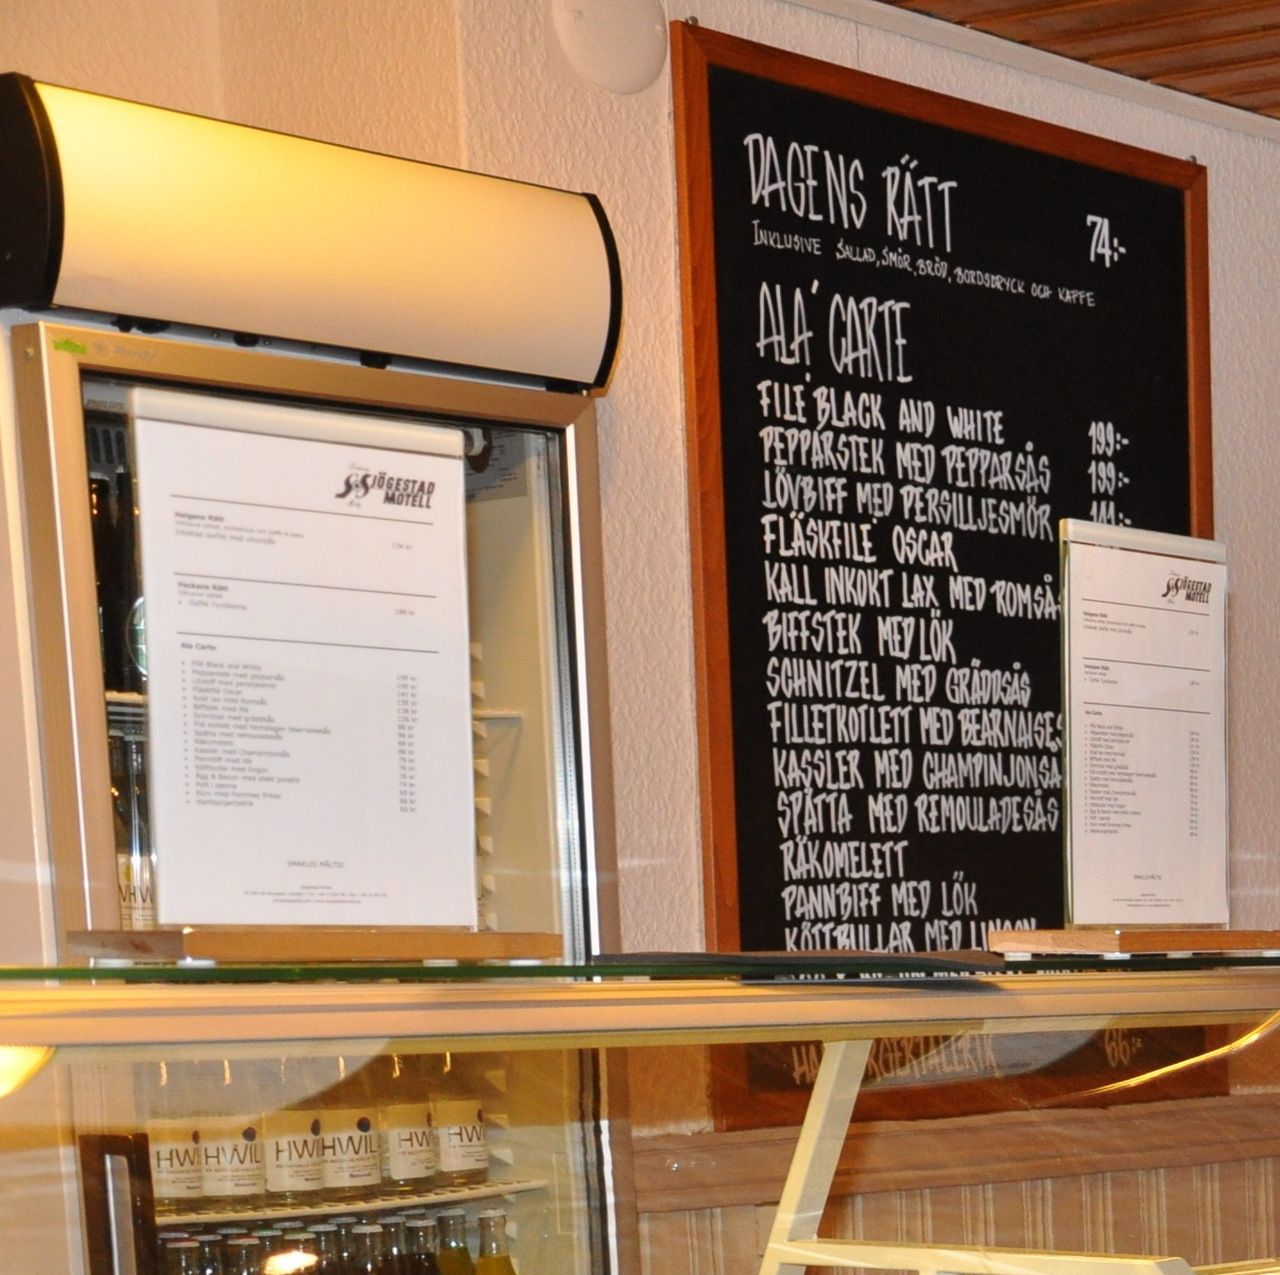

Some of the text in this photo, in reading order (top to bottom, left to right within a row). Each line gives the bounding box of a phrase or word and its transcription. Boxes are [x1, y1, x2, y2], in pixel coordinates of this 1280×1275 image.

[744, 133, 867, 230] DAGENS
[881, 153, 957, 252] RÄTT
[751, 219, 822, 255] INKLUSIVE
[954, 267, 1025, 294] BORDSDRYCK
[1030, 281, 1053, 299] OCH
[828, 293, 912, 383] CARTE
[813, 385, 886, 431] BLACK
[898, 398, 935, 439] AND
[946, 405, 1005, 445] WHITE
[758, 426, 885, 476] PEPPARSTEK
[895, 442, 936, 485] MED
[941, 441, 1051, 494] PEPPARSÅS
[383, 491, 432, 509] MOTELL
[761, 467, 848, 514] LÖVBIFF
[856, 481, 894, 518] MED
[901, 484, 1054, 542] PERSILLJESMÖR
[892, 525, 959, 572] OSCAR
[764, 560, 1062, 620] KALL INKOKT LAX MED ROMSÅ
[762, 608, 957, 664] BIFFSTEK MED LÖK
[766, 656, 886, 701] SCHNITZEL
[896, 664, 937, 703] MED
[946, 658, 1032, 708] GRÄDDSÅS
[767, 701, 913, 744] FILLETKOTLETT
[919, 707, 954, 745] MED
[772, 747, 865, 790] KASSLER
[874, 748, 914, 789] MED
[868, 793, 909, 834] MED
[914, 789, 1060, 834] REMOULADESÅS
[779, 834, 909, 881] RÄKOMELETT
[781, 871, 979, 921] PANNBIFF MED LÖK
[924, 917, 963, 951] MED
